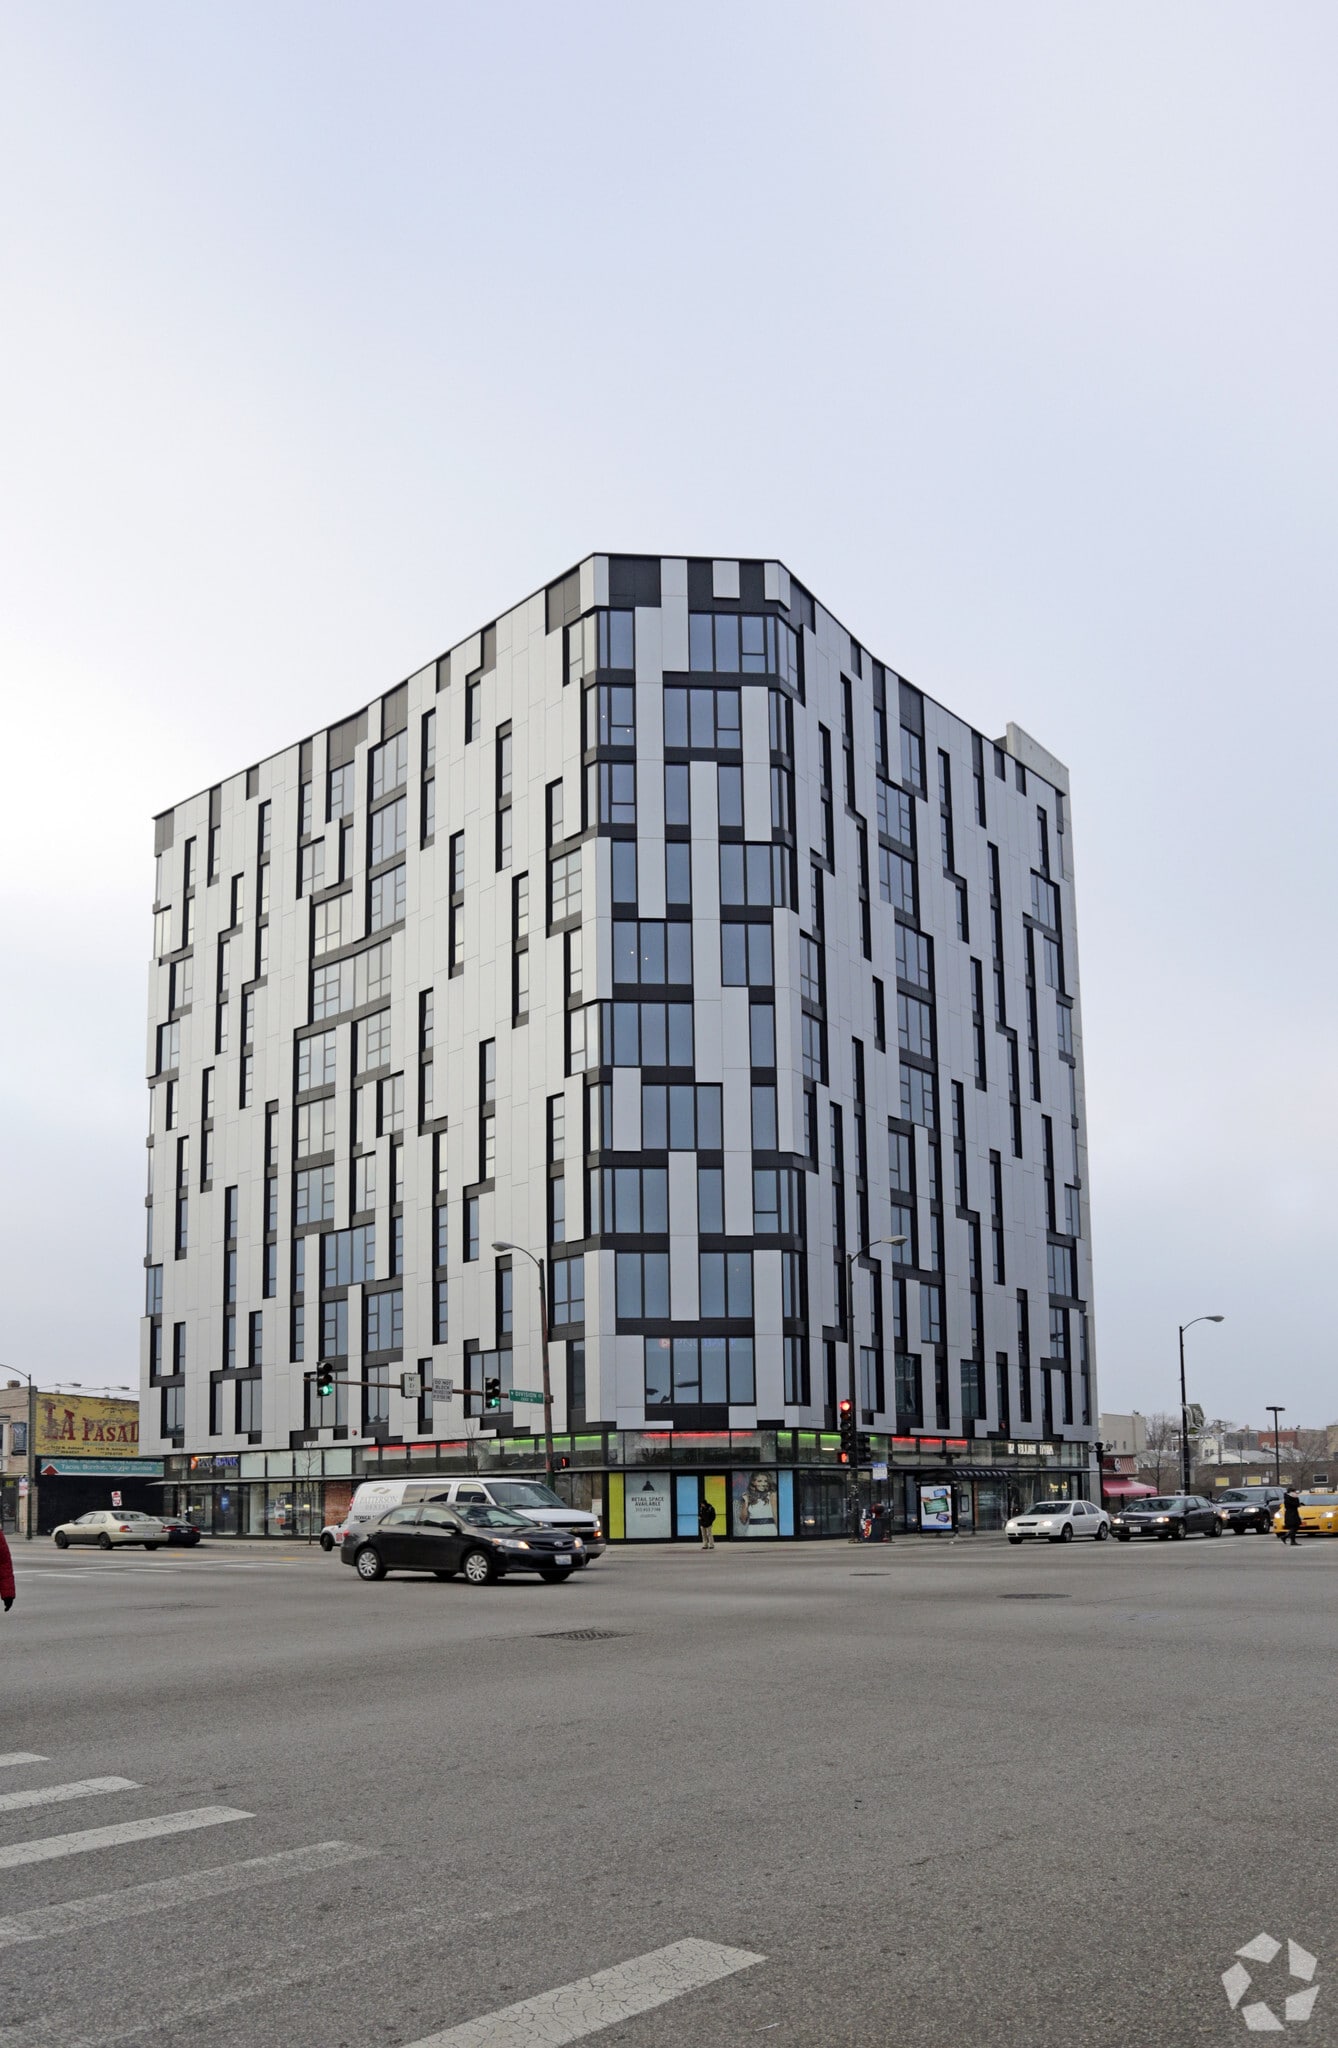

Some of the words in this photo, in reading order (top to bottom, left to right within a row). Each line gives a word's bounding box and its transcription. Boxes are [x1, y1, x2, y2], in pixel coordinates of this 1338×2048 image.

[45, 1401, 76, 1441] LA
[215, 1457, 239, 1467] BANK
[360, 1495, 399, 1505] PATTERSON
